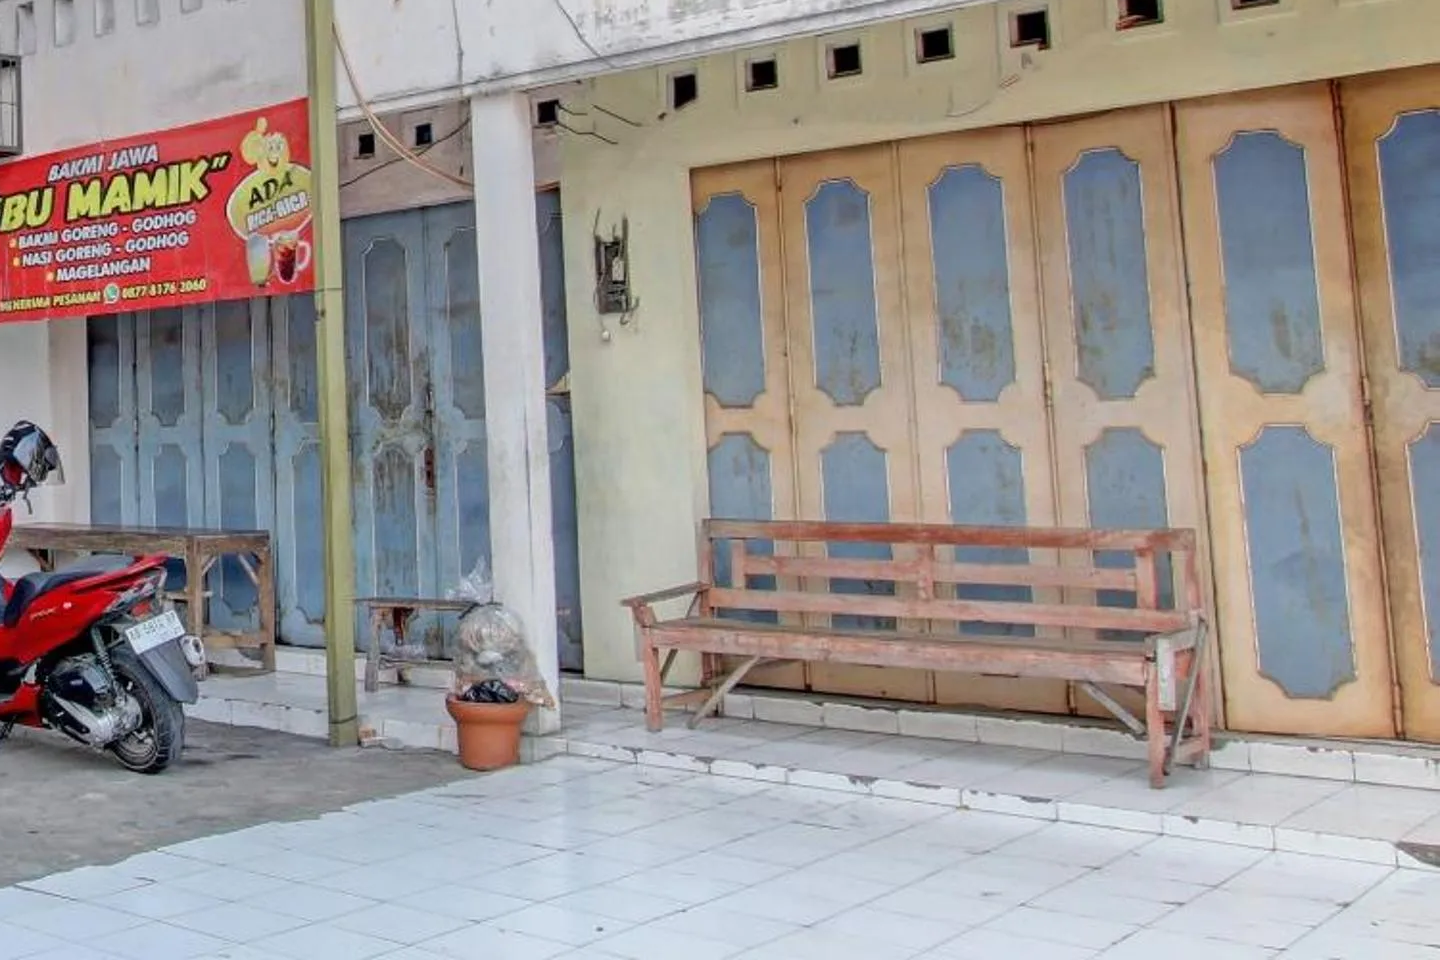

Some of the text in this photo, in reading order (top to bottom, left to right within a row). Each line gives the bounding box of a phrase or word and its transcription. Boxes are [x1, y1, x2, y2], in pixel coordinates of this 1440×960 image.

[49, 144, 159, 182] BAKMI JAWA
[249, 171, 293, 209] ADA
[61, 222, 118, 243] GORENG
[132, 210, 196, 232] GODHOG
[22, 250, 52, 267] NASI
[56, 243, 111, 262] GORENG
[125, 231, 189, 253] GODHOG
[56, 257, 150, 282] MAGELANGAN
